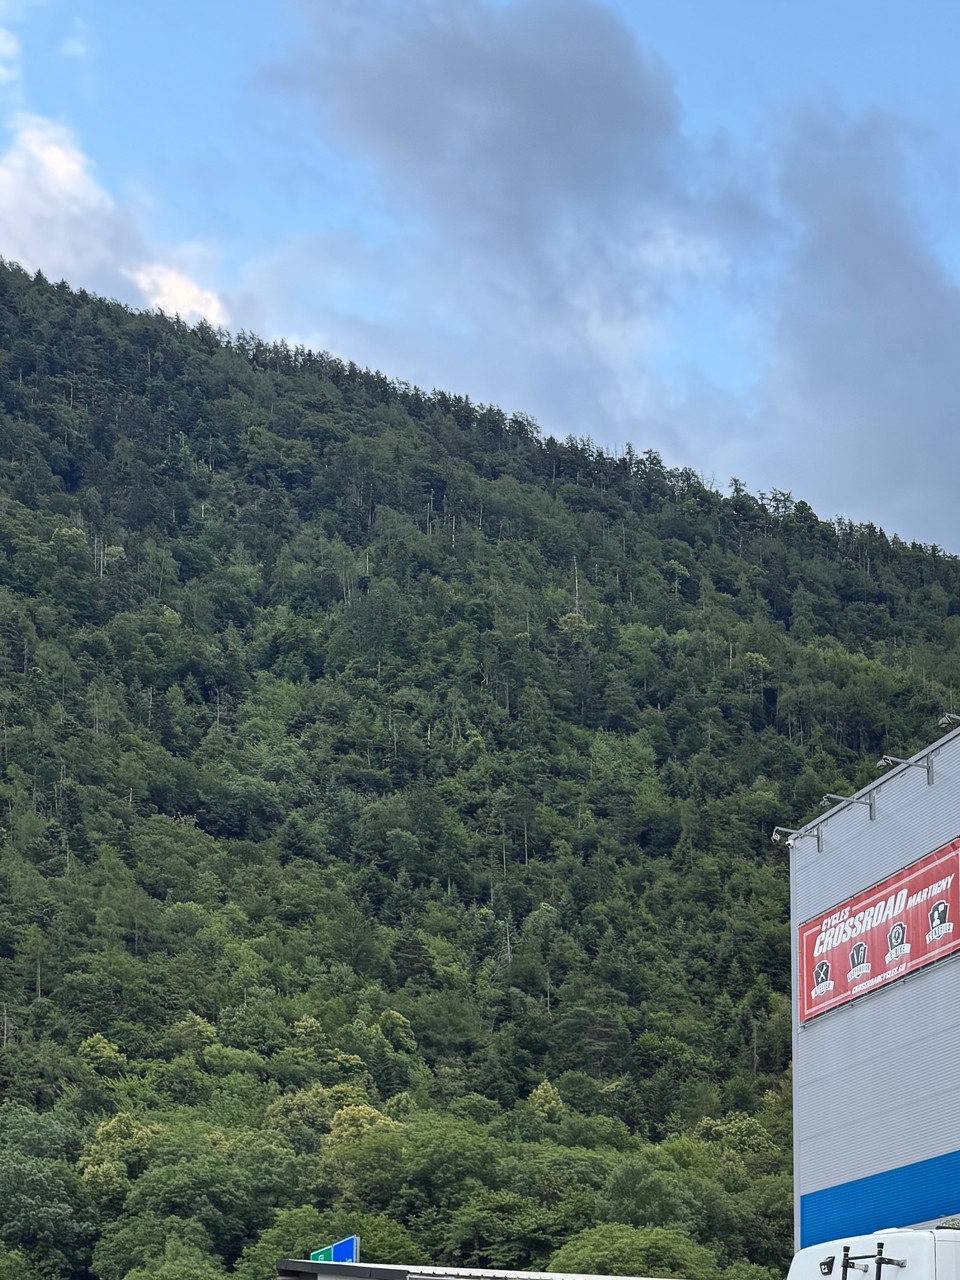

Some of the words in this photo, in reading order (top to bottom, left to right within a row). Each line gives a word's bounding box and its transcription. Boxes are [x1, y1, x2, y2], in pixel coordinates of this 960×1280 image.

[813, 888, 908, 957] CROSSROAD
[906, 873, 955, 910] MARTIGNY
[821, 906, 851, 931] CYCLES
